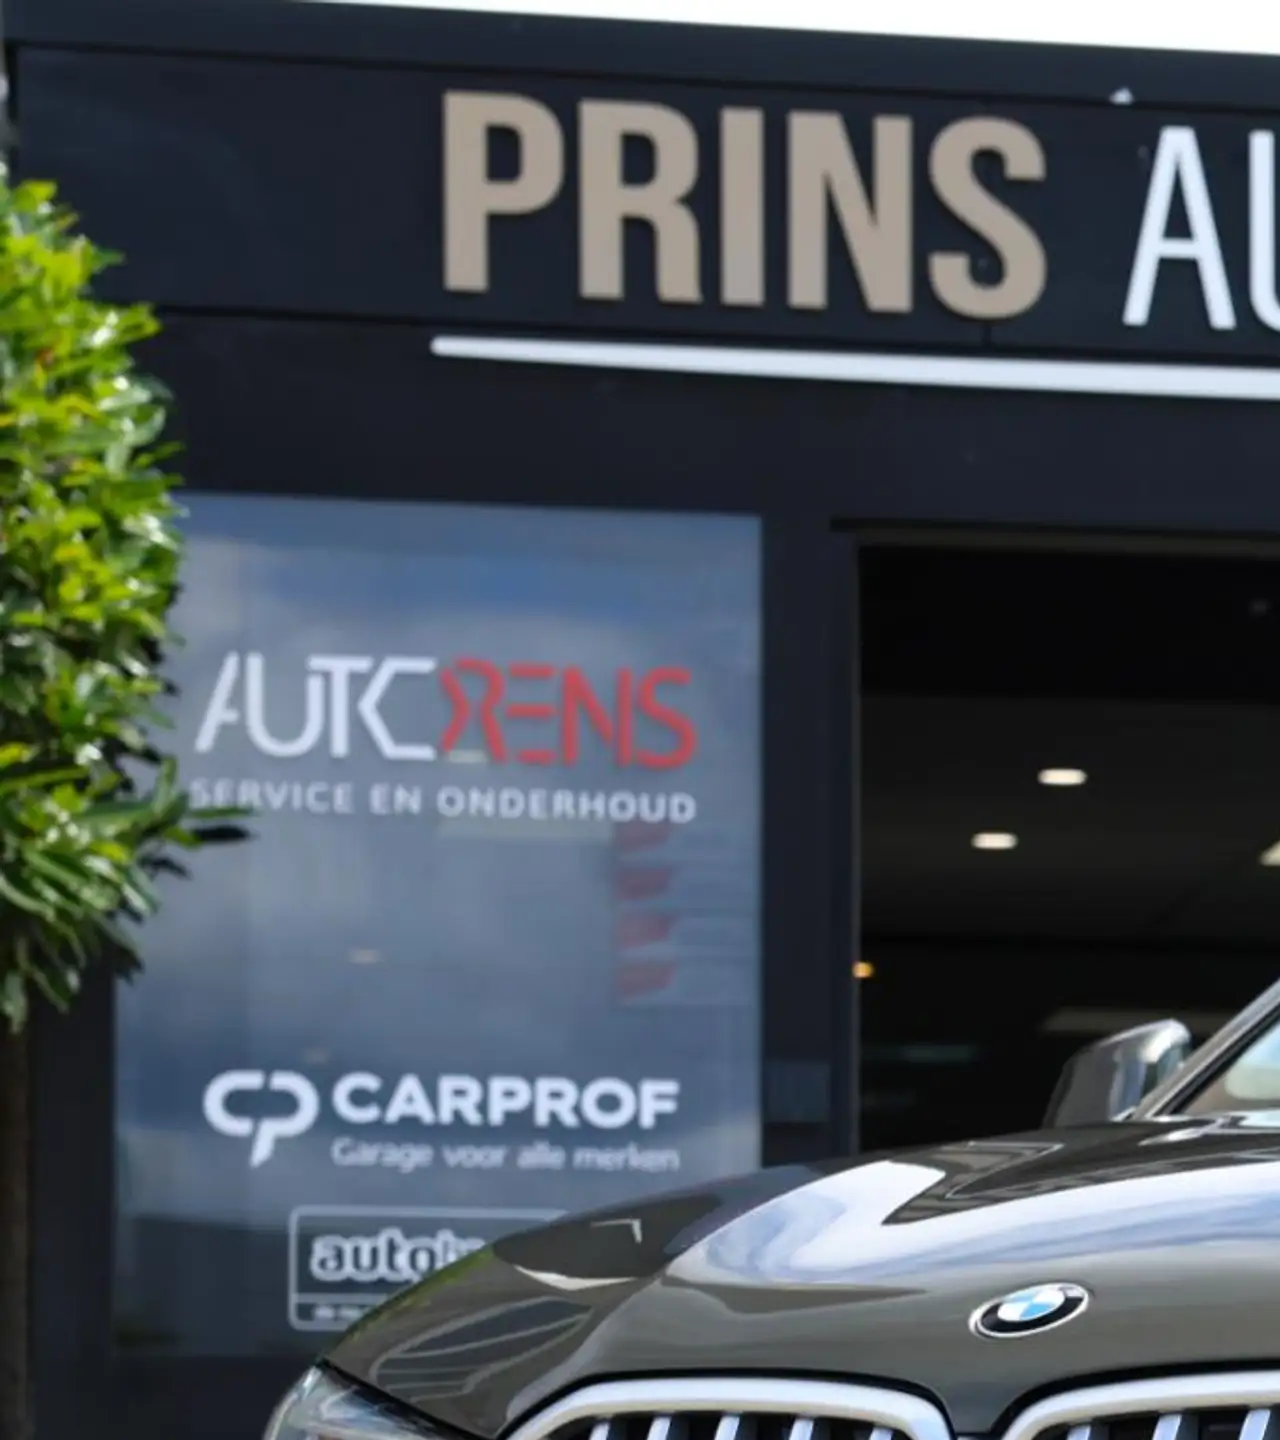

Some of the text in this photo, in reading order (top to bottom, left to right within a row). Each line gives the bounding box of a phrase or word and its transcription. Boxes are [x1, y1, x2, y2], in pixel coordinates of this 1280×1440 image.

[442, 89, 1049, 320] PRINS
[188, 777, 698, 824] SERVICE EN ONDERHOUD
[331, 1071, 682, 1130] CARPROF
[331, 1136, 682, 1174] Garage voor alle merken
